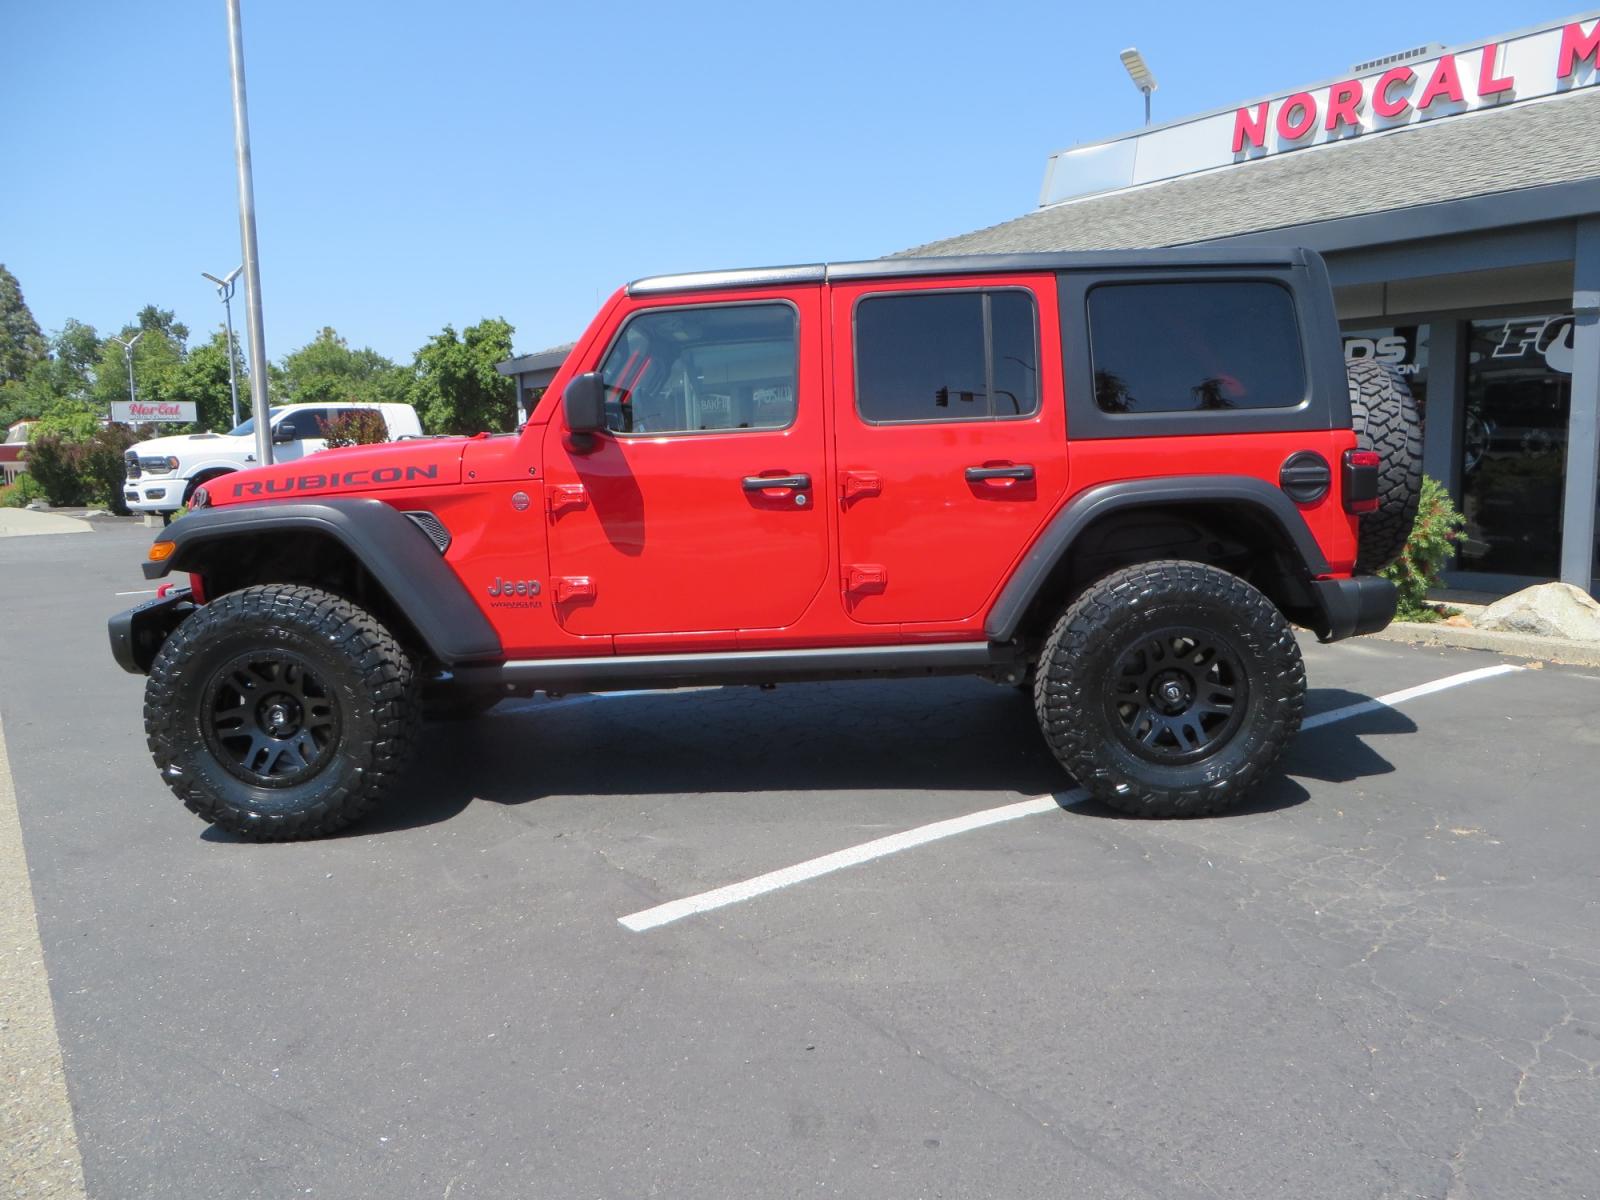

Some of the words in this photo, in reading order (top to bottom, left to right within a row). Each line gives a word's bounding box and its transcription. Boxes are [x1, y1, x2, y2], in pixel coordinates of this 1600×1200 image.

[1231, 43, 1515, 154] NORCAL
[232, 464, 438, 497] RUBICON
[487, 576, 541, 597] Jeep
